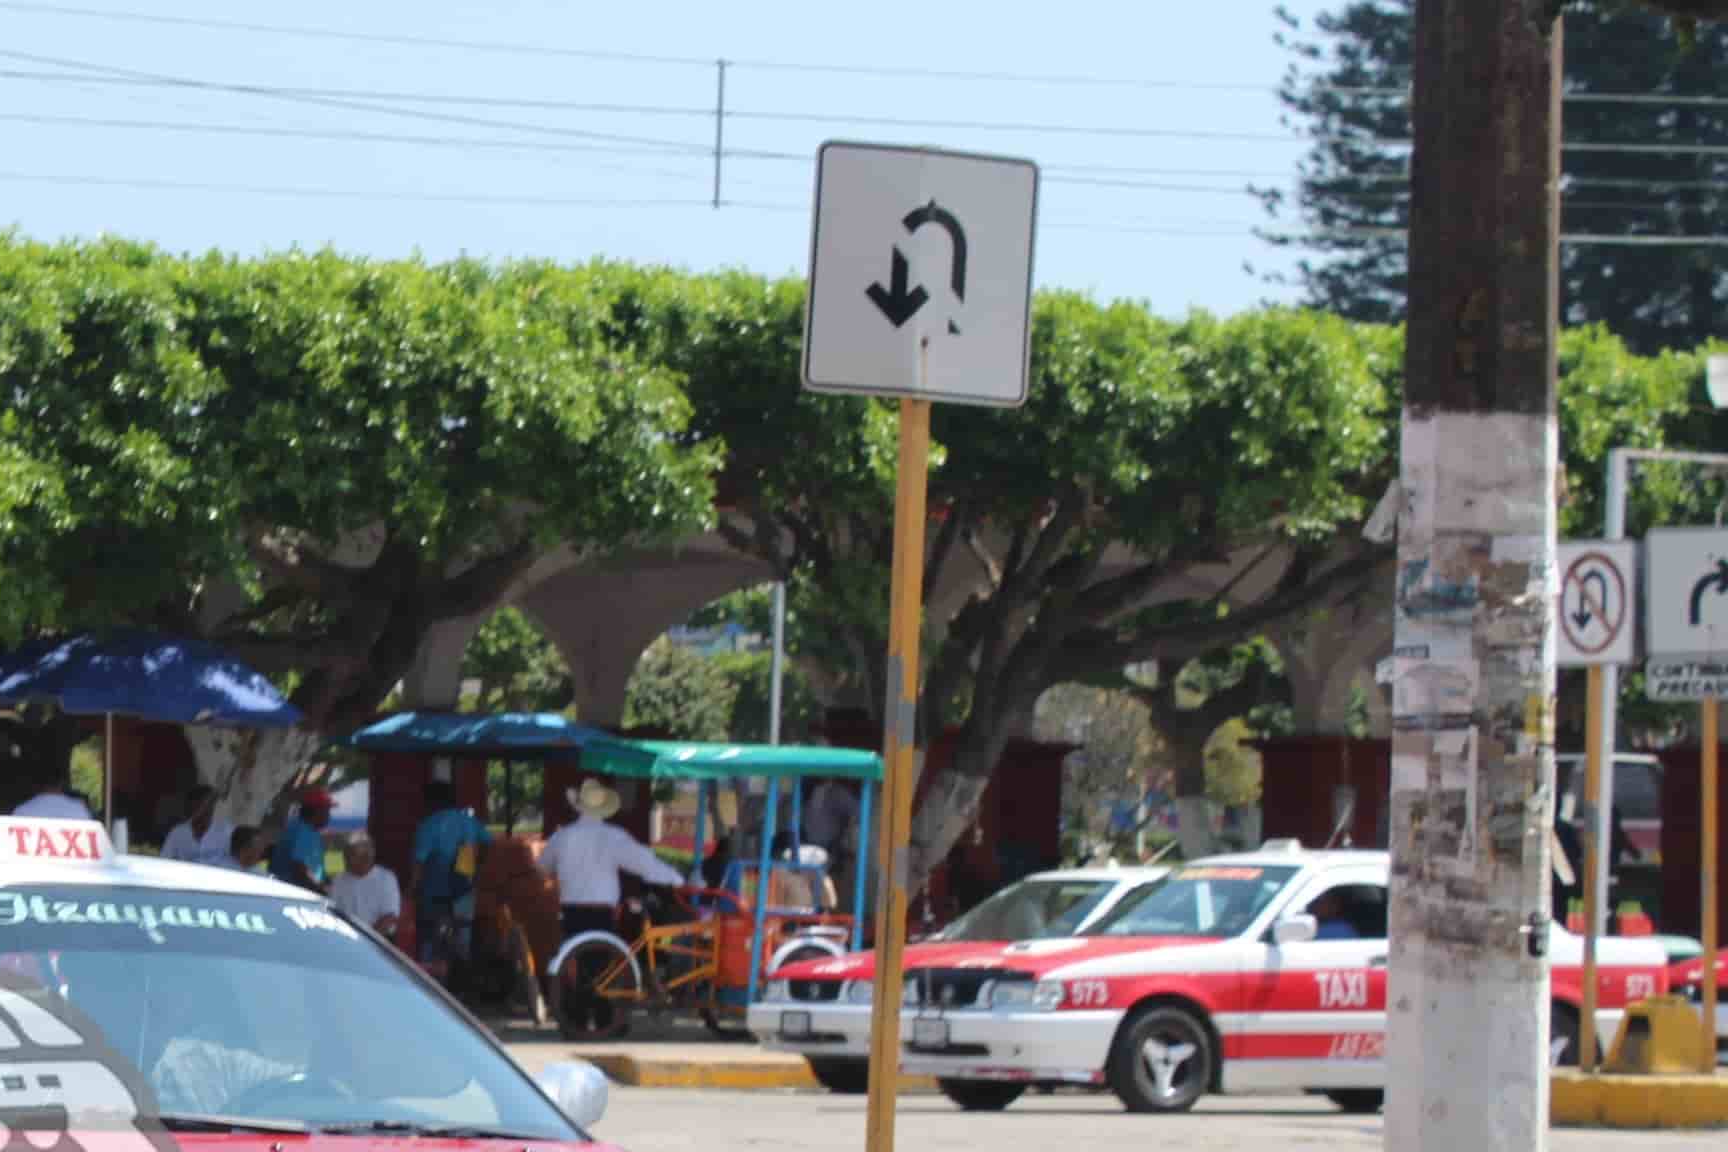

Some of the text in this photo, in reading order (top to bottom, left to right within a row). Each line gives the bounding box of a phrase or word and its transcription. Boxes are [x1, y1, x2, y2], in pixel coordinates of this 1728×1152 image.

[8, 826, 103, 860] TAXI
[1071, 979, 1109, 1005] 573
[1313, 972, 1368, 1008] TAXI
